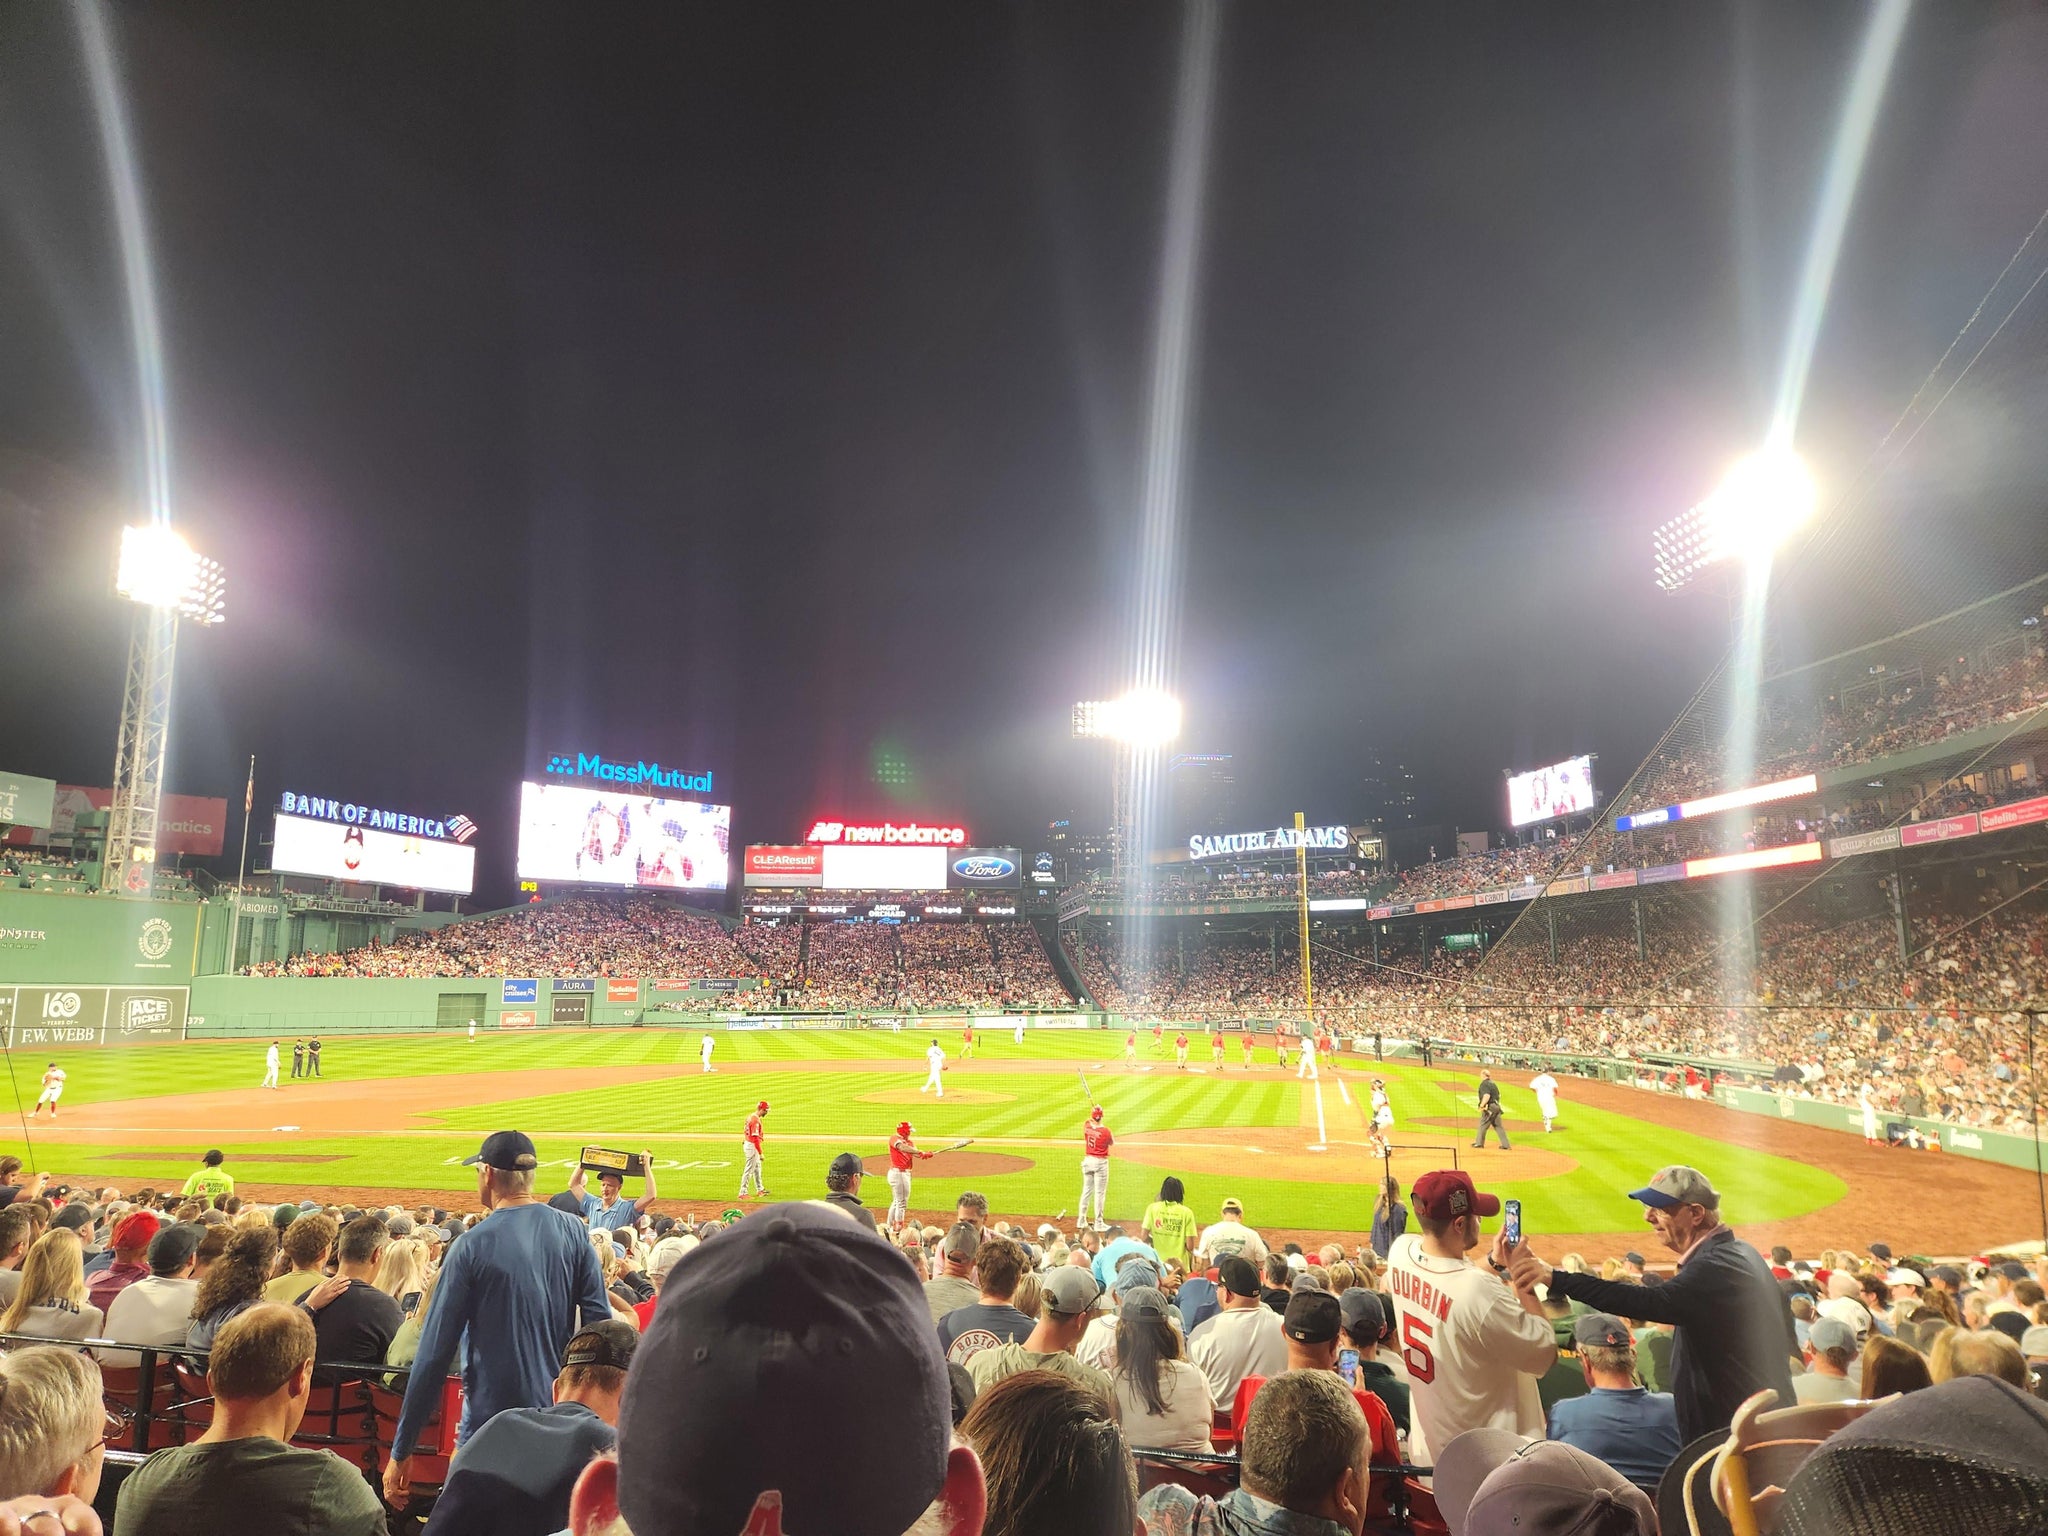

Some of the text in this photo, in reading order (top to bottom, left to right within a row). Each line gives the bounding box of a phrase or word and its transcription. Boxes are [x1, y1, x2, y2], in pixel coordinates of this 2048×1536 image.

[577, 752, 713, 792] MassMutual
[282, 791, 445, 838] BANK OF AMERICA
[160, 819, 213, 834] natics
[1189, 825, 1348, 860] SAMUEL ADAMS
[752, 855, 816, 865] CLEAResult
[965, 860, 1004, 876] Ford
[240, 903, 278, 914] ABIOMED
[505, 984, 518, 993] city
[505, 989, 527, 997] cruises
[42, 992, 81, 1018] 160
[131, 999, 168, 1015] ACE
[131, 1013, 168, 1027] TICKET
[187, 1016, 205, 1025] 379
[21, 1027, 95, 1044] F.W. WEBB
[1392, 1267, 1454, 1324] DURBIN
[957, 1334, 995, 1351] BOSTO
[1402, 1310, 1435, 1385] 5
